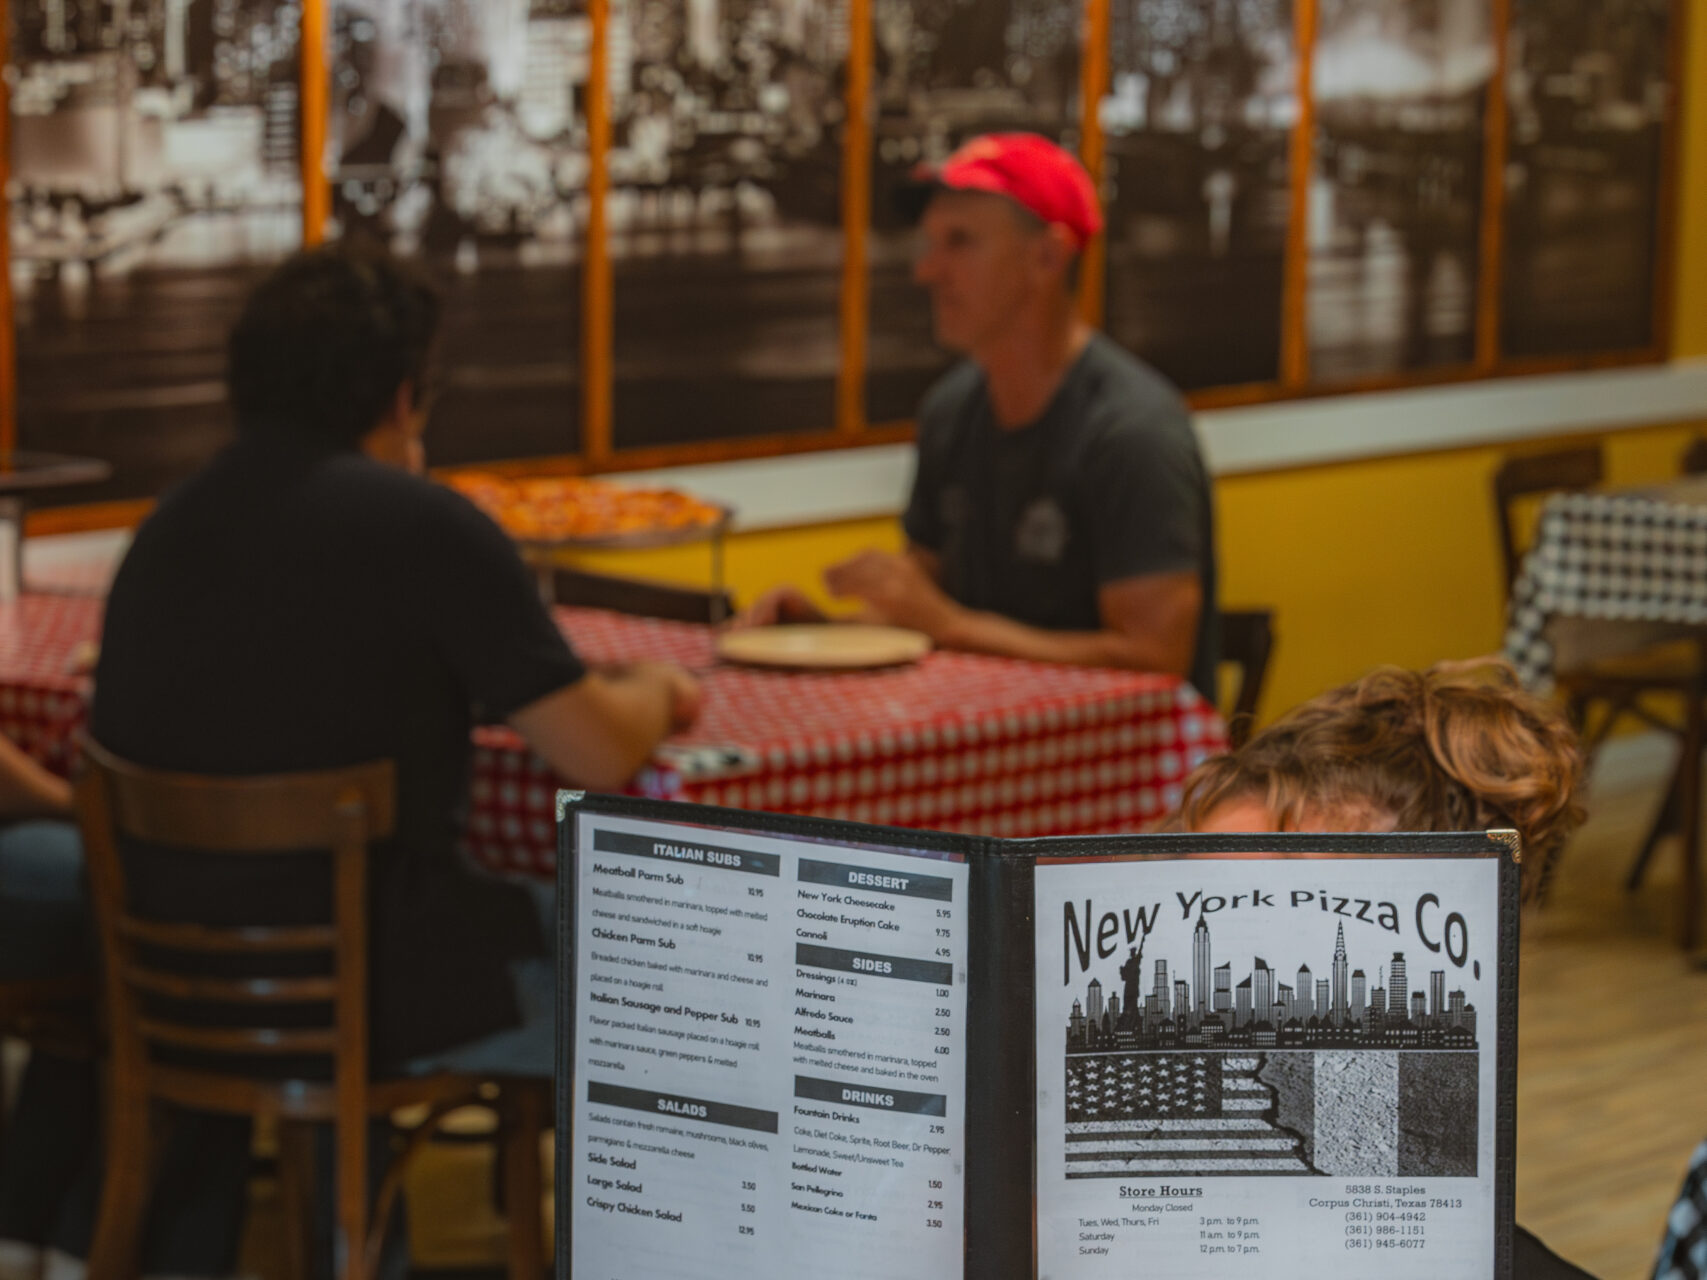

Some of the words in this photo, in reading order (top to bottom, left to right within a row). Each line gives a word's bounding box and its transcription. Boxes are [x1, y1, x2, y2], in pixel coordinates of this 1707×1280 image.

[653, 843, 703, 861] ITALIAN
[707, 851, 741, 867] SUBS
[593, 862, 635, 878] Meatball
[638, 870, 663, 882] Parm
[666, 873, 684, 885] Sub
[848, 871, 908, 890] DESSERT
[797, 890, 818, 900] New
[821, 893, 841, 903] York
[844, 895, 894, 911] Cheesecake
[797, 908, 837, 922] Chocolate
[840, 914, 875, 929] Eruption
[877, 920, 899, 931] Cake
[936, 909, 951, 918] 5.95
[591, 927, 627, 942] Chicken
[630, 934, 655, 946] Parm
[658, 937, 675, 949] Sub
[796, 928, 827, 940] Cannoli
[935, 928, 950, 937] 9.75
[1064, 899, 1161, 986] New
[1175, 889, 1275, 920] York
[1291, 890, 1400, 935] Pizza
[1415, 892, 1480, 981] Co.
[935, 947, 950, 957] 4.95
[852, 957, 892, 973] SIDES
[796, 969, 835, 984] Dressings
[795, 987, 835, 1001] Marinara
[936, 989, 948, 997] 1.00
[590, 991, 618, 1005] Italian
[621, 997, 660, 1014] Sausage
[663, 1003, 682, 1015] and
[684, 1007, 717, 1023] Pepper
[721, 1012, 738, 1024] Sub
[935, 1008, 949, 1017] 2.50
[794, 1007, 825, 1019] Alfredo
[828, 1011, 853, 1023] Sauce
[794, 1026, 835, 1040] Meatballs
[934, 1027, 949, 1036] 2.50
[934, 1045, 949, 1054] 6.00
[911, 1058, 936, 1070] topped
[834, 1061, 858, 1072] cheese
[860, 1065, 873, 1074] and
[875, 1067, 897, 1077] baked
[906, 1071, 918, 1080] the
[920, 1074, 938, 1082] oven
[842, 1088, 894, 1107] DRINKS
[657, 1098, 707, 1118] SALADS
[793, 1105, 830, 1119] Fountain
[832, 1111, 859, 1123] Drinks
[929, 1125, 944, 1134] 2.95
[873, 1138, 890, 1147] Root
[587, 1152, 607, 1165] Side
[609, 1156, 636, 1169] Salad
[891, 1158, 904, 1167] Tea
[792, 1162, 816, 1173] Bottled
[819, 1166, 842, 1176] Water
[587, 1174, 612, 1190] Large
[616, 1179, 642, 1193] Salad
[741, 1180, 755, 1191] 3.50
[928, 1180, 942, 1188] 1.50
[791, 1181, 804, 1191] San
[806, 1183, 843, 1199] Pellegrino
[1120, 1185, 1155, 1197] Store
[1160, 1185, 1203, 1197] Hours
[1346, 1185, 1371, 1194] 5838
[1374, 1185, 1383, 1194] S.
[1386, 1185, 1426, 1196] Staples
[586, 1196, 614, 1212] Crispy
[617, 1202, 652, 1217] Chicken
[655, 1209, 682, 1223] Salad
[927, 1200, 942, 1209] 2.95
[1132, 1203, 1165, 1213] Monday
[1166, 1203, 1192, 1212] Closed
[1309, 1198, 1349, 1209] Corpus
[1353, 1198, 1392, 1208] Christi,
[1395, 1199, 1426, 1207] Texas
[1430, 1199, 1462, 1208] 78413
[790, 1201, 822, 1213] Mexican
[824, 1206, 843, 1216] Coke
[855, 1211, 876, 1221] Fanta
[1345, 1212, 1372, 1222] (361)
[1376, 1212, 1426, 1221] 904-4942
[926, 1219, 941, 1228] 3.50
[1200, 1217, 1205, 1225] 3
[1079, 1232, 1115, 1242] Saturday
[1345, 1226, 1372, 1236] (361)
[1376, 1226, 1425, 1234] 986-1151
[1345, 1239, 1372, 1249] (361)
[1376, 1239, 1425, 1248] 945-6077
[1079, 1246, 1109, 1255] Sunday
